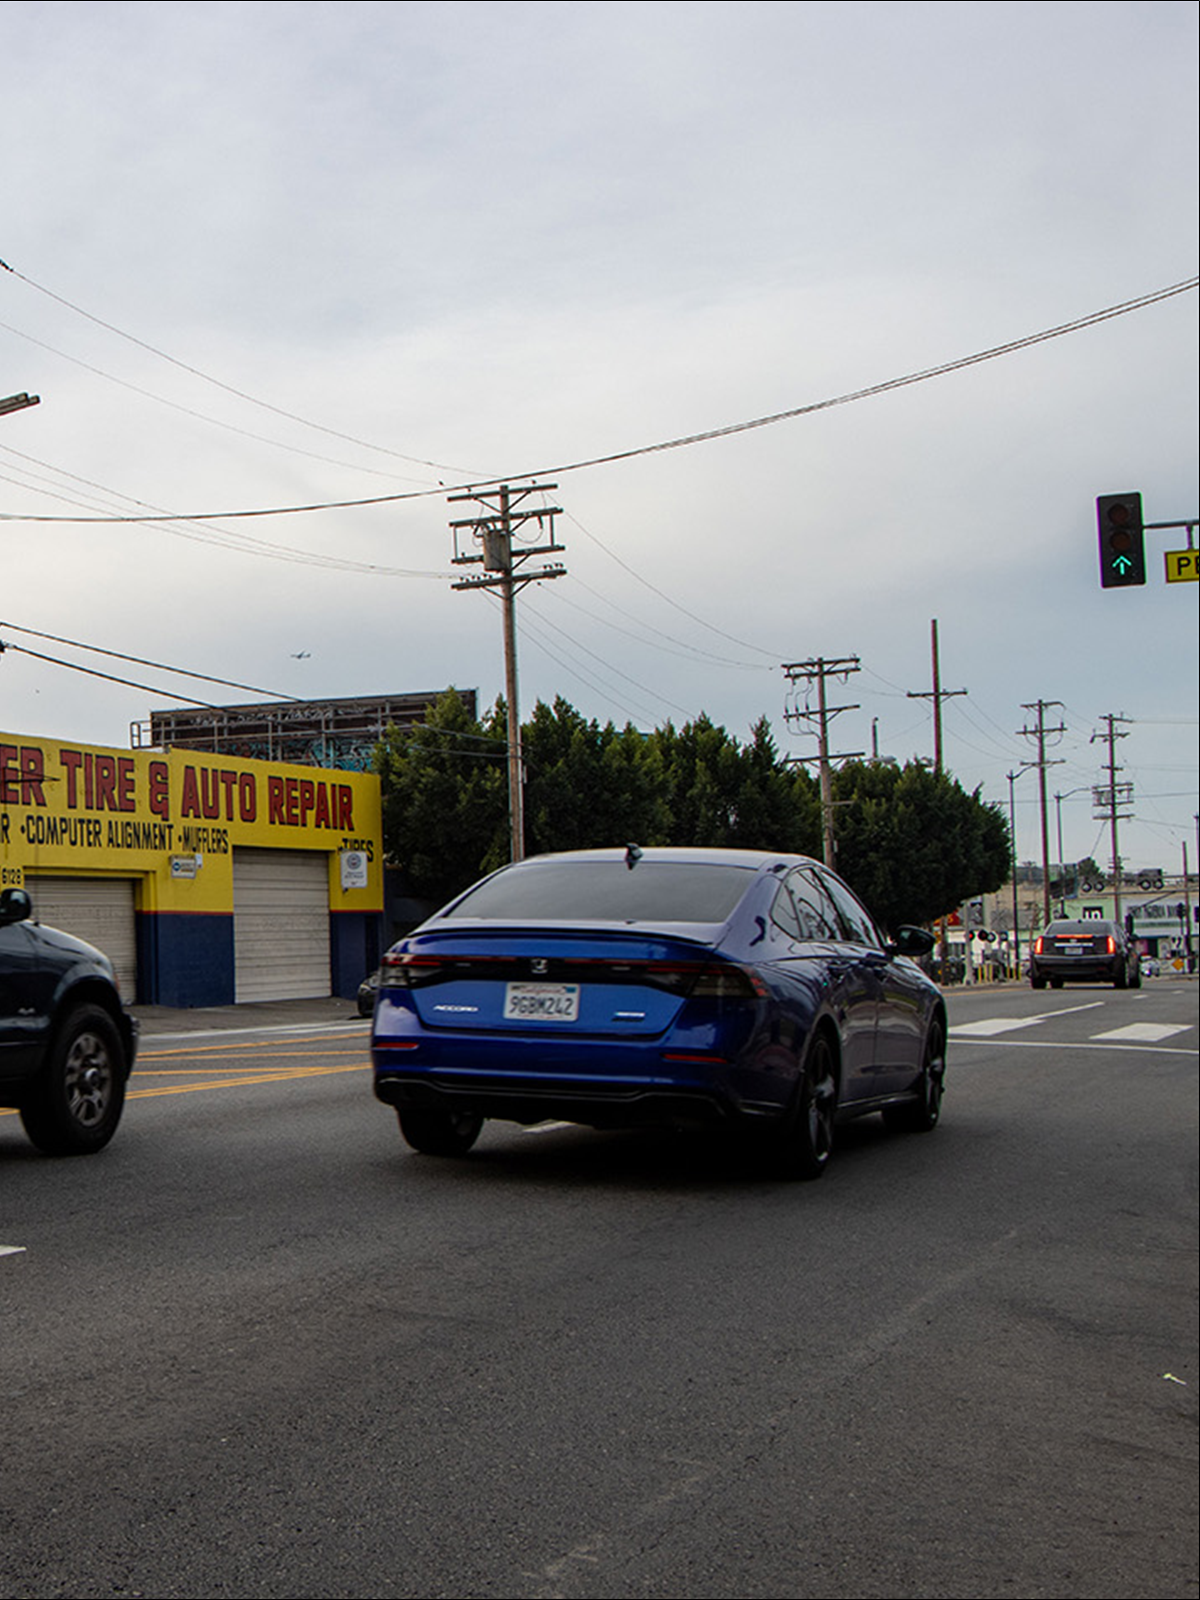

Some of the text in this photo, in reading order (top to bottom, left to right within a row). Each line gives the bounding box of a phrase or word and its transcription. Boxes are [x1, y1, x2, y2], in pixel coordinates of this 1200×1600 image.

[60, 749, 136, 813] TIRE
[148, 760, 170, 821] &
[181, 765, 257, 823] AUTO
[267, 775, 355, 832] REPAIR
[26, 815, 102, 848] COMPUTER
[107, 821, 174, 850] ALIGNMENT
[182, 826, 229, 854] MUFFLERS
[2, 868, 21, 884] 6128
[509, 995, 574, 1016] 9GBM242
